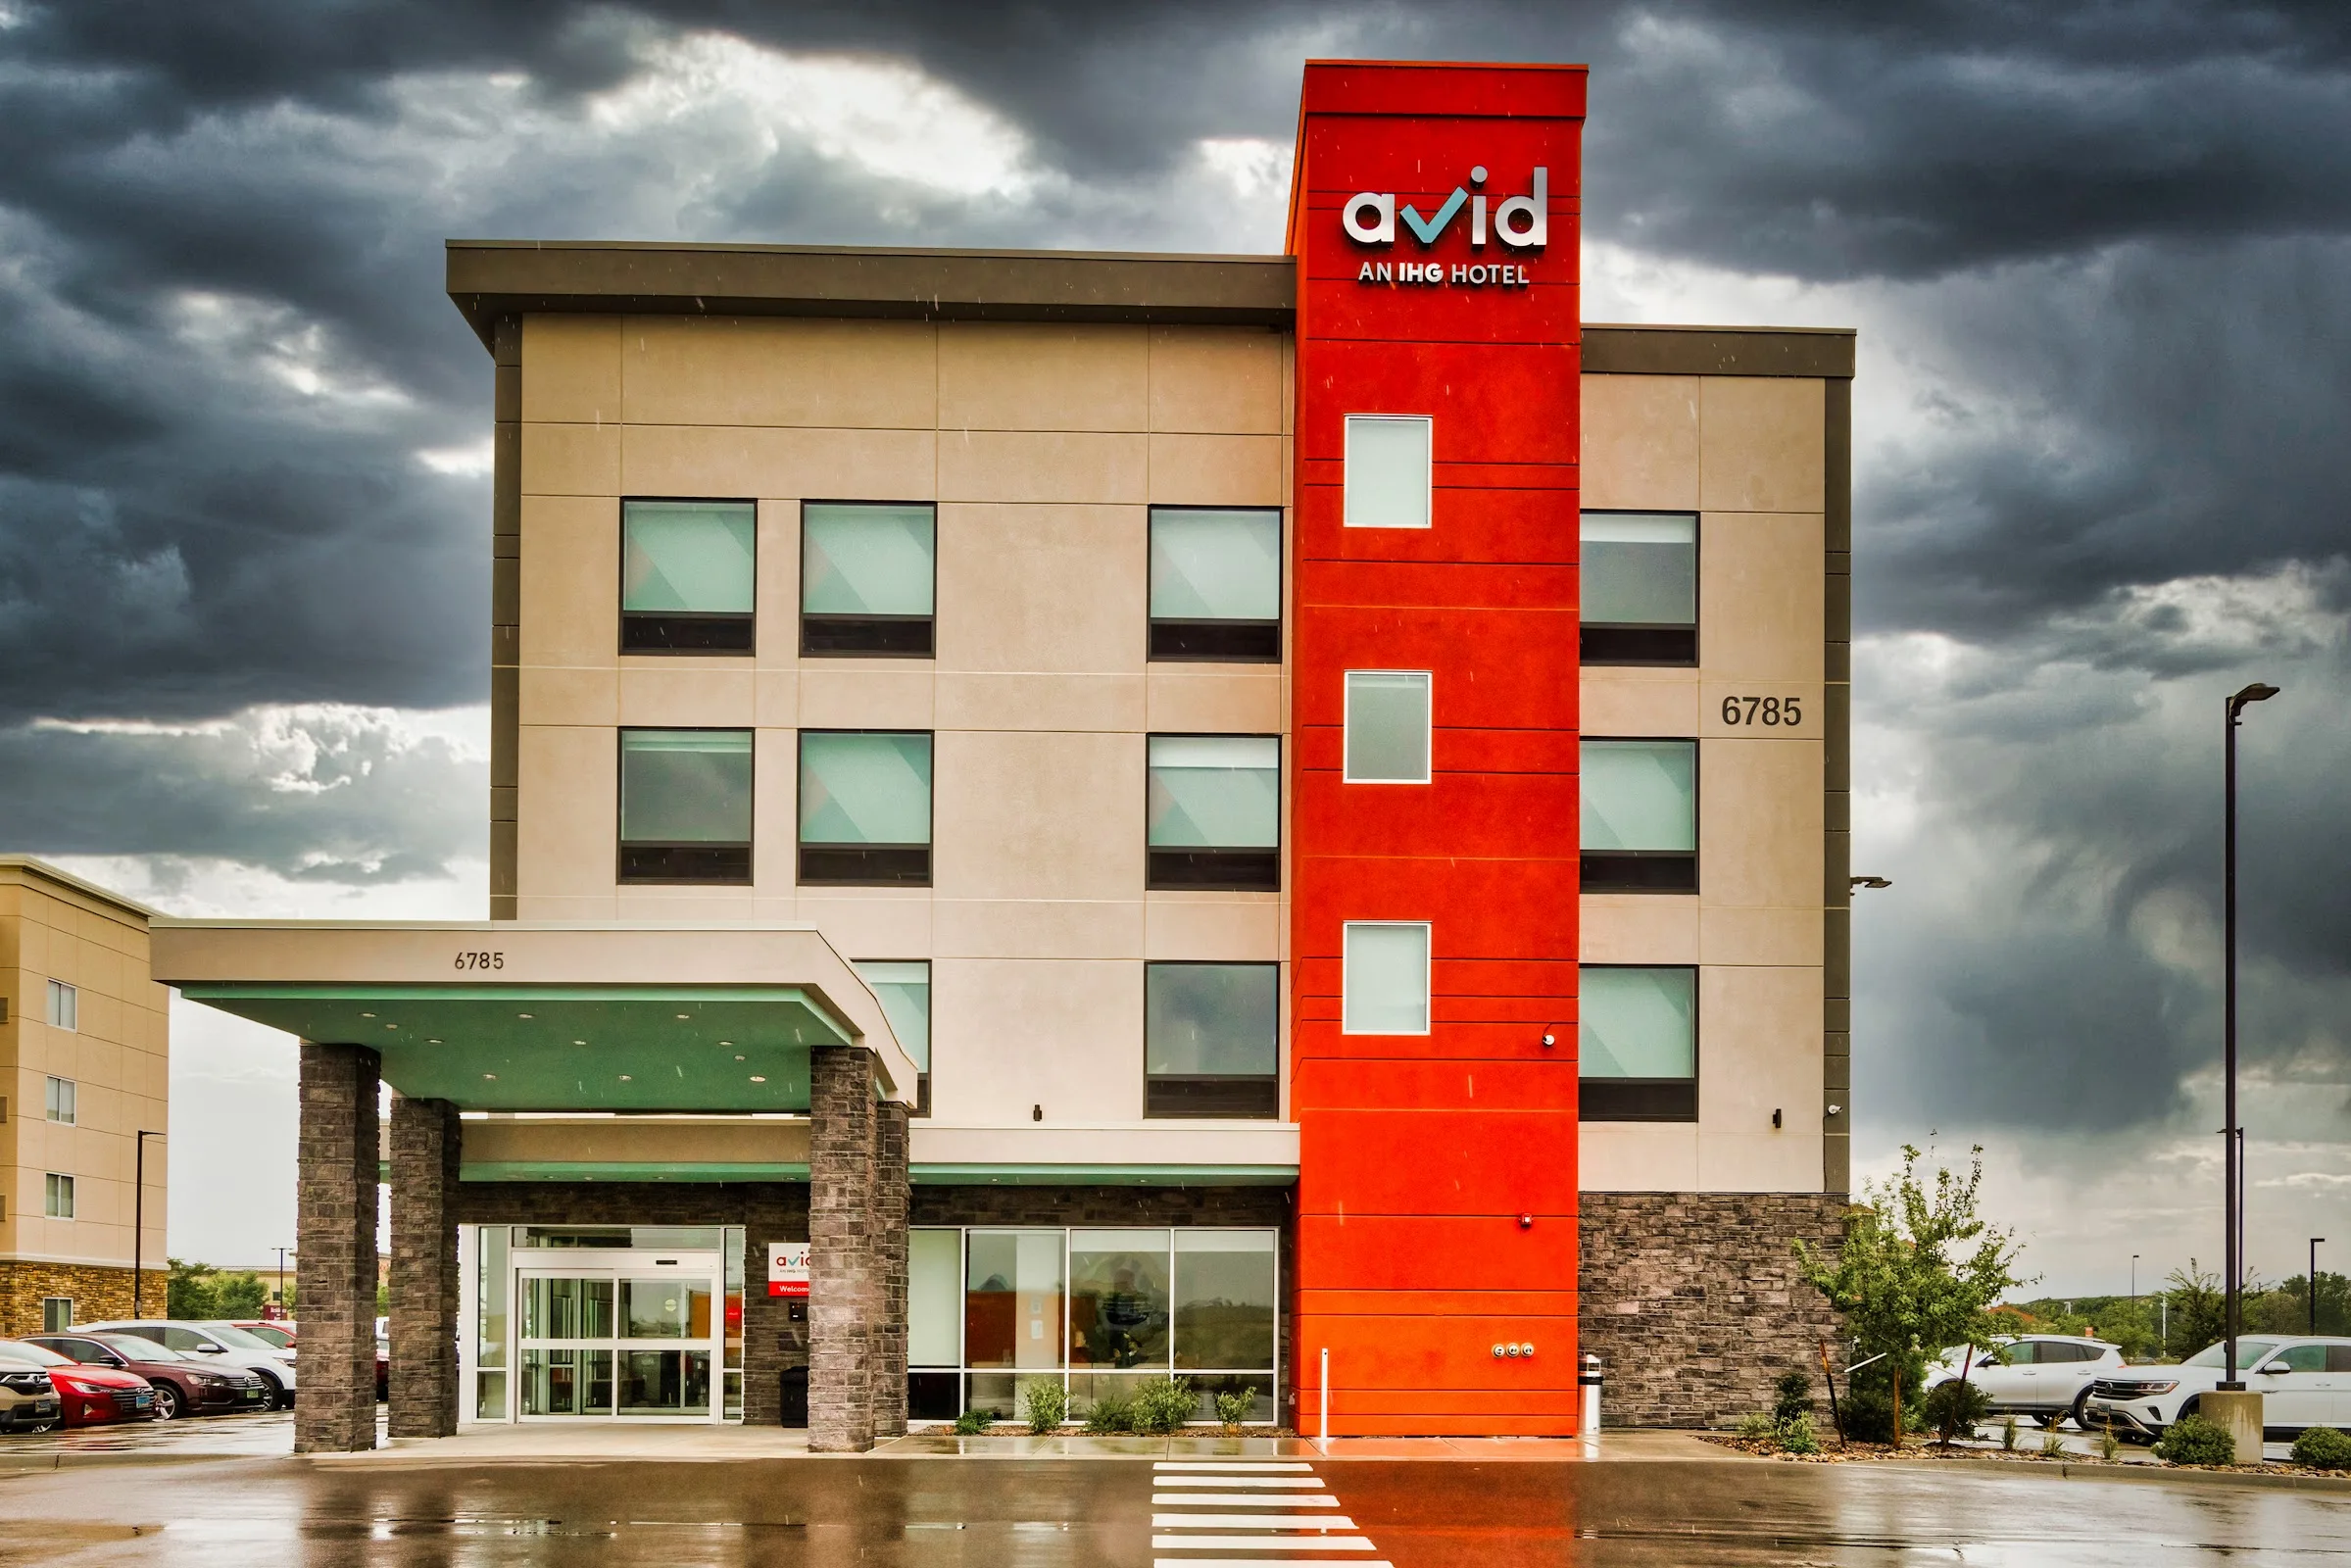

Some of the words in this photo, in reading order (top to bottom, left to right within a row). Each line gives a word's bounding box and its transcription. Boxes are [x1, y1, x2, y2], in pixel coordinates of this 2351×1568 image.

[1343, 166, 1547, 247] avid
[1358, 262, 1392, 282] AN
[1398, 262, 1444, 282] IHG
[1451, 264, 1530, 284] HOTEL
[1722, 696, 1801, 726] 6785
[455, 952, 504, 970] 6785
